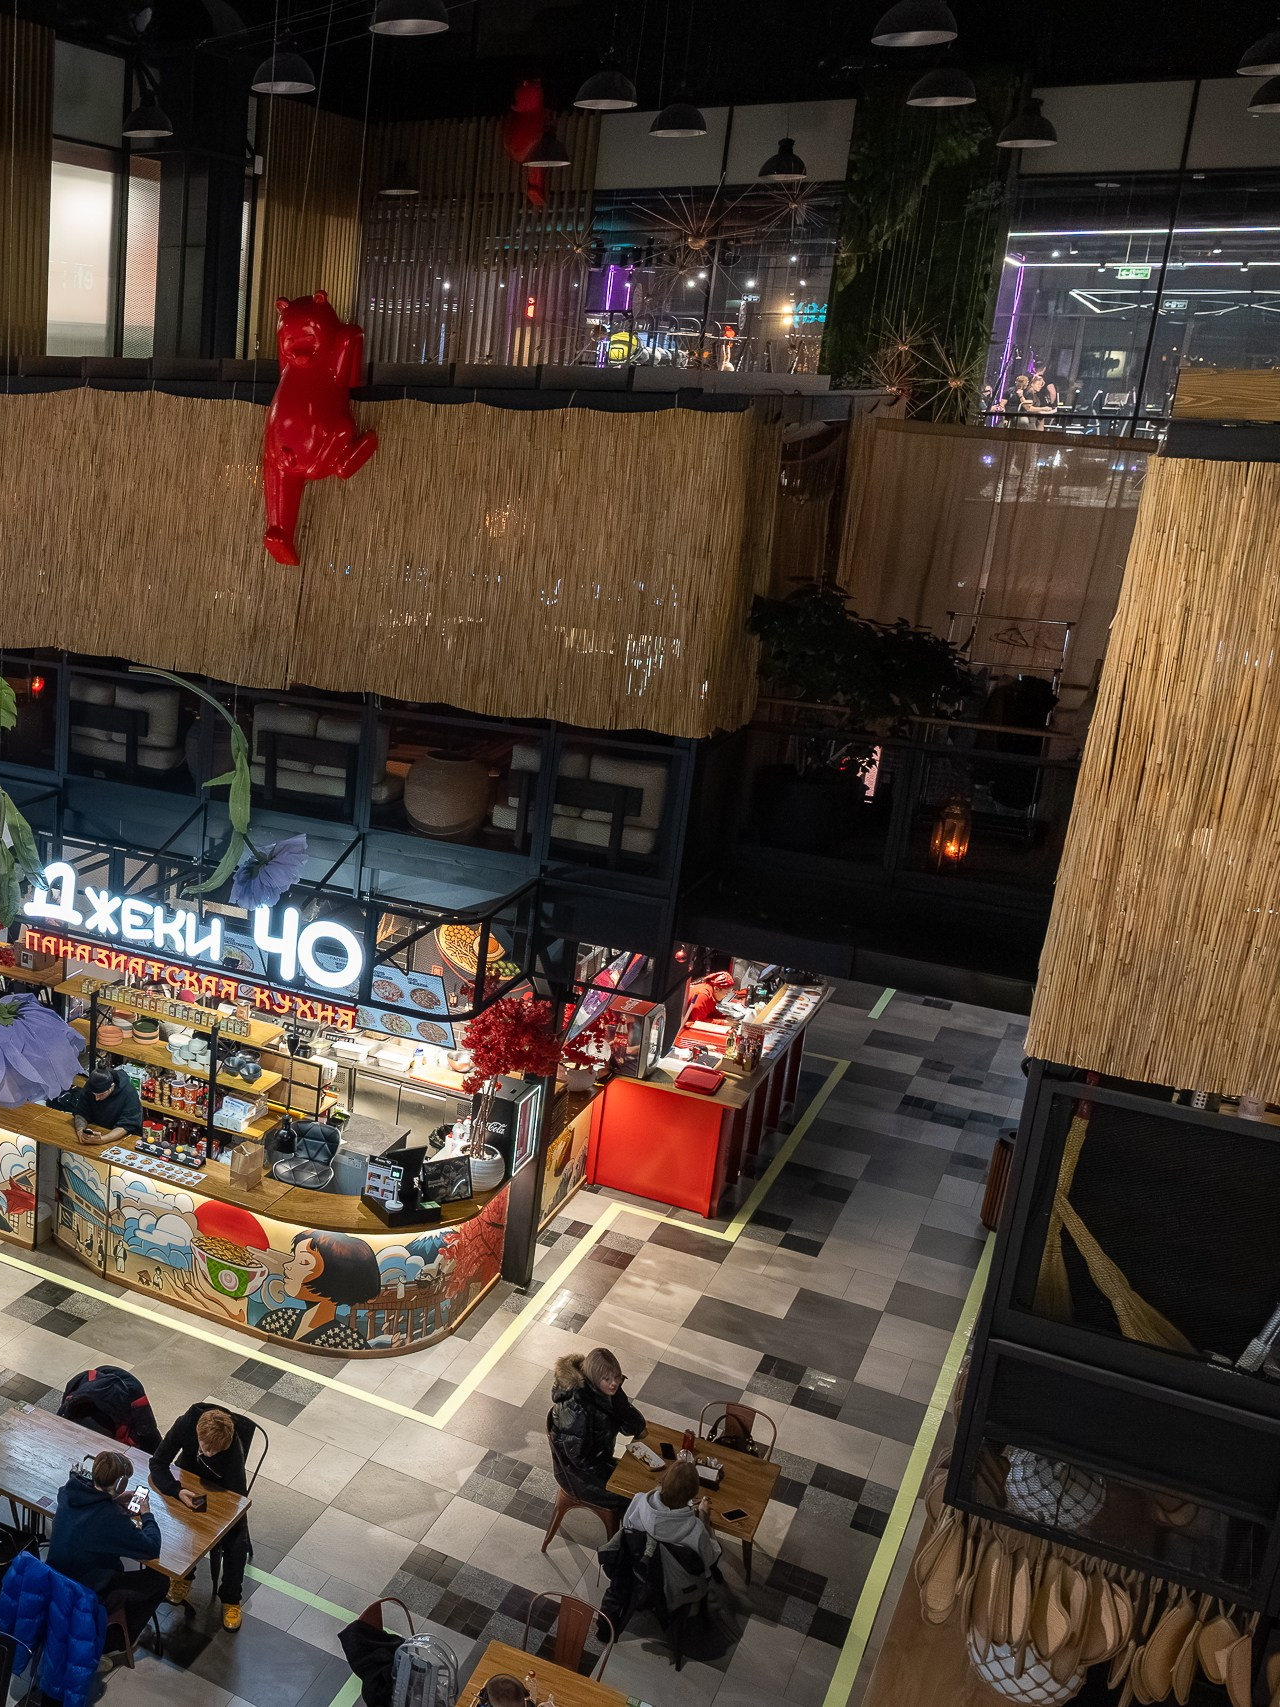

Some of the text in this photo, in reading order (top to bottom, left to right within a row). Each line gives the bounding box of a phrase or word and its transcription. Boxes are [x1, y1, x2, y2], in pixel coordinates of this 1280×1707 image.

[24, 928, 357, 1031] ПАНАЗИАТСКАЯ КУХНЯ
[254, 903, 363, 989] ЧО
